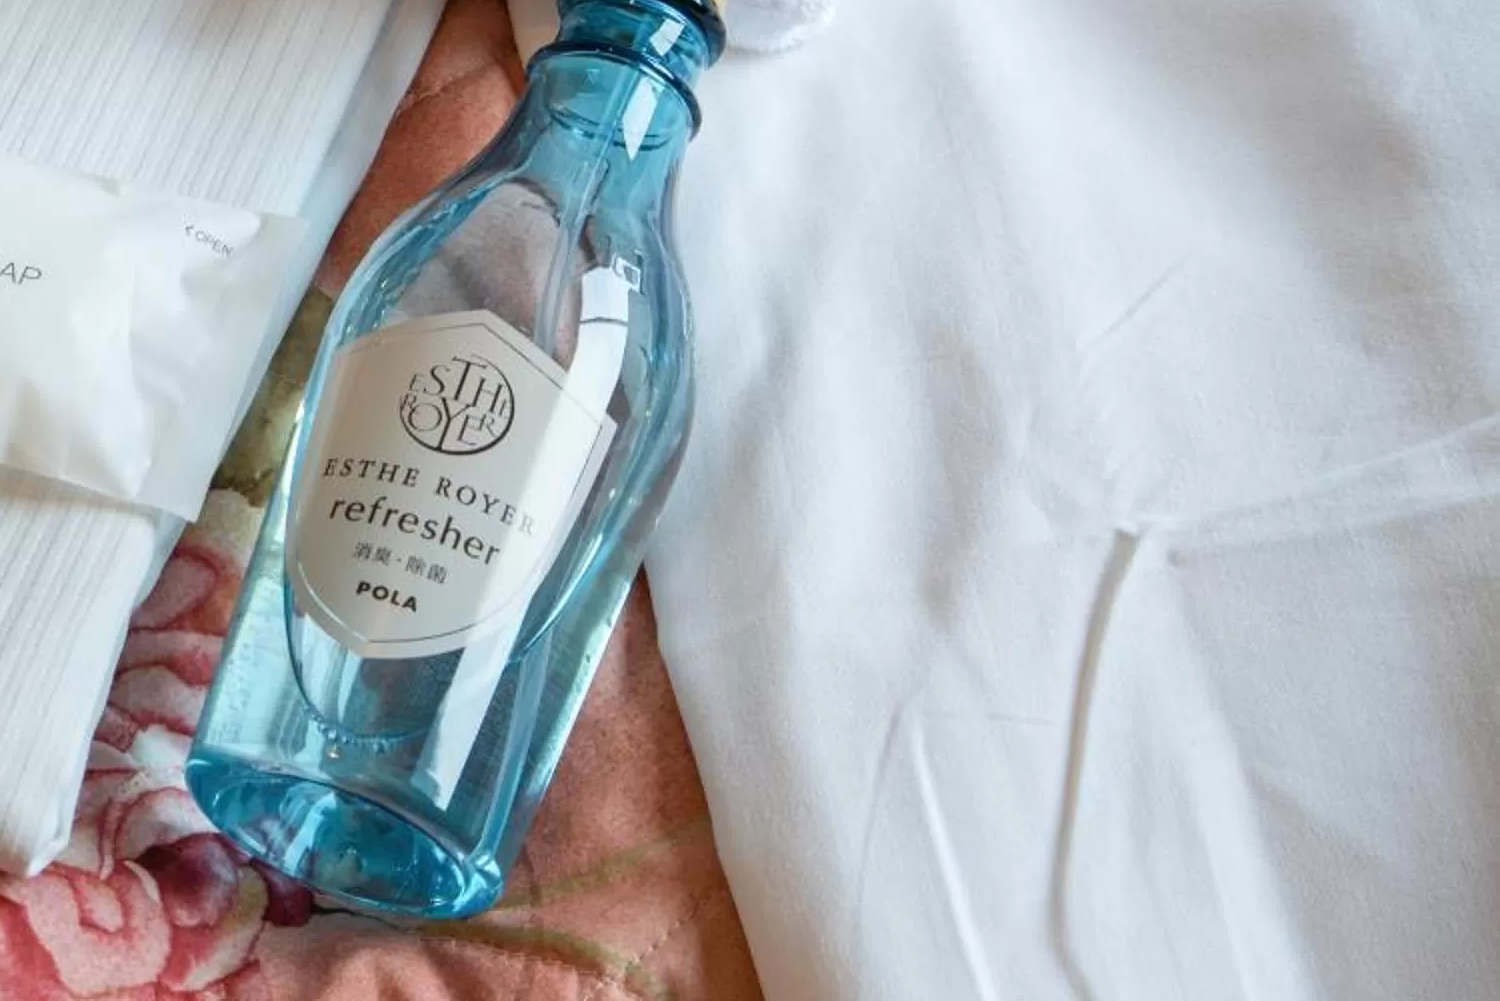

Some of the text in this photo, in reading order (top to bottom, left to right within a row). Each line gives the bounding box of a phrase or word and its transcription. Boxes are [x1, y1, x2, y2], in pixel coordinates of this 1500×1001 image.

[323, 457, 535, 537] ESTHE ROYER
[329, 496, 500, 566] refresher
[356, 581, 419, 613] POLA
